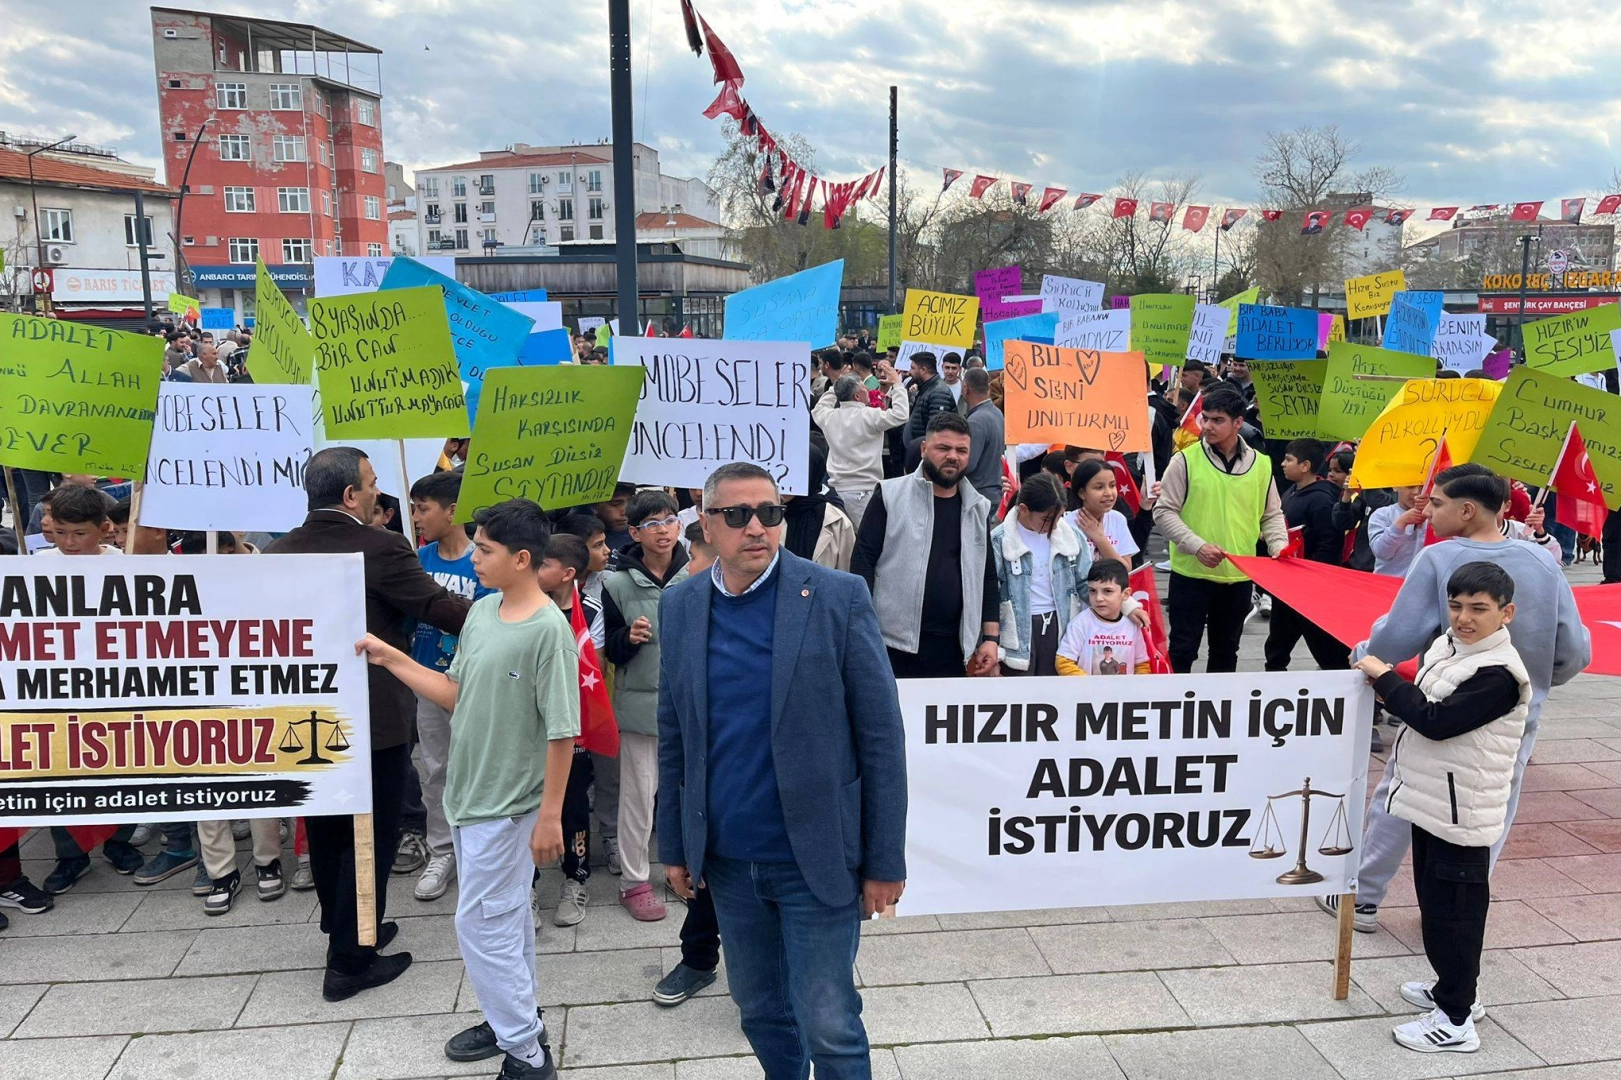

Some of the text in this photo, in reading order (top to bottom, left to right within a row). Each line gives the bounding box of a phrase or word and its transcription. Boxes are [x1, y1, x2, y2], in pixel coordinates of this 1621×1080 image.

[84, 278, 117, 294] BARIŞ
[200, 273, 235, 281] ANBARCI
[917, 295, 968, 315] ACIMIZ
[1260, 306, 1288, 317] BABA
[1539, 301, 1553, 310] ÇAY
[1553, 300, 1587, 310] BAHÇESİ
[12, 318, 124, 351] ADALET
[312, 302, 328, 340] 8
[909, 314, 964, 337] BÜYÜK
[1240, 316, 1294, 335] ADALET
[313, 339, 353, 372] BİR
[1431, 340, 1483, 356] RKADAŞIM
[46, 358, 141, 390] ALLAH
[639, 354, 811, 414] MOBESELER
[493, 386, 584, 413] HAKSIZLIK
[0, 426, 101, 456] EVER
[518, 416, 616, 439] KARŞISINDA
[0, 575, 202, 617] ANLARA
[95, 619, 313, 660] ETMEYENE
[1088, 638, 1133, 646] İSTİYORUZ
[17, 665, 219, 700] MERHAMET
[231, 663, 338, 695] ETMEZ
[924, 688, 1345, 747] HIZIR METİN İÇİN
[67, 713, 275, 770] İSTİYORUZ
[1026, 754, 1238, 798] ADALET
[45, 792, 86, 813] için
[95, 790, 168, 809] adalet
[176, 788, 276, 811] istiyoruz
[988, 806, 1251, 856] İSTİYORUZ
